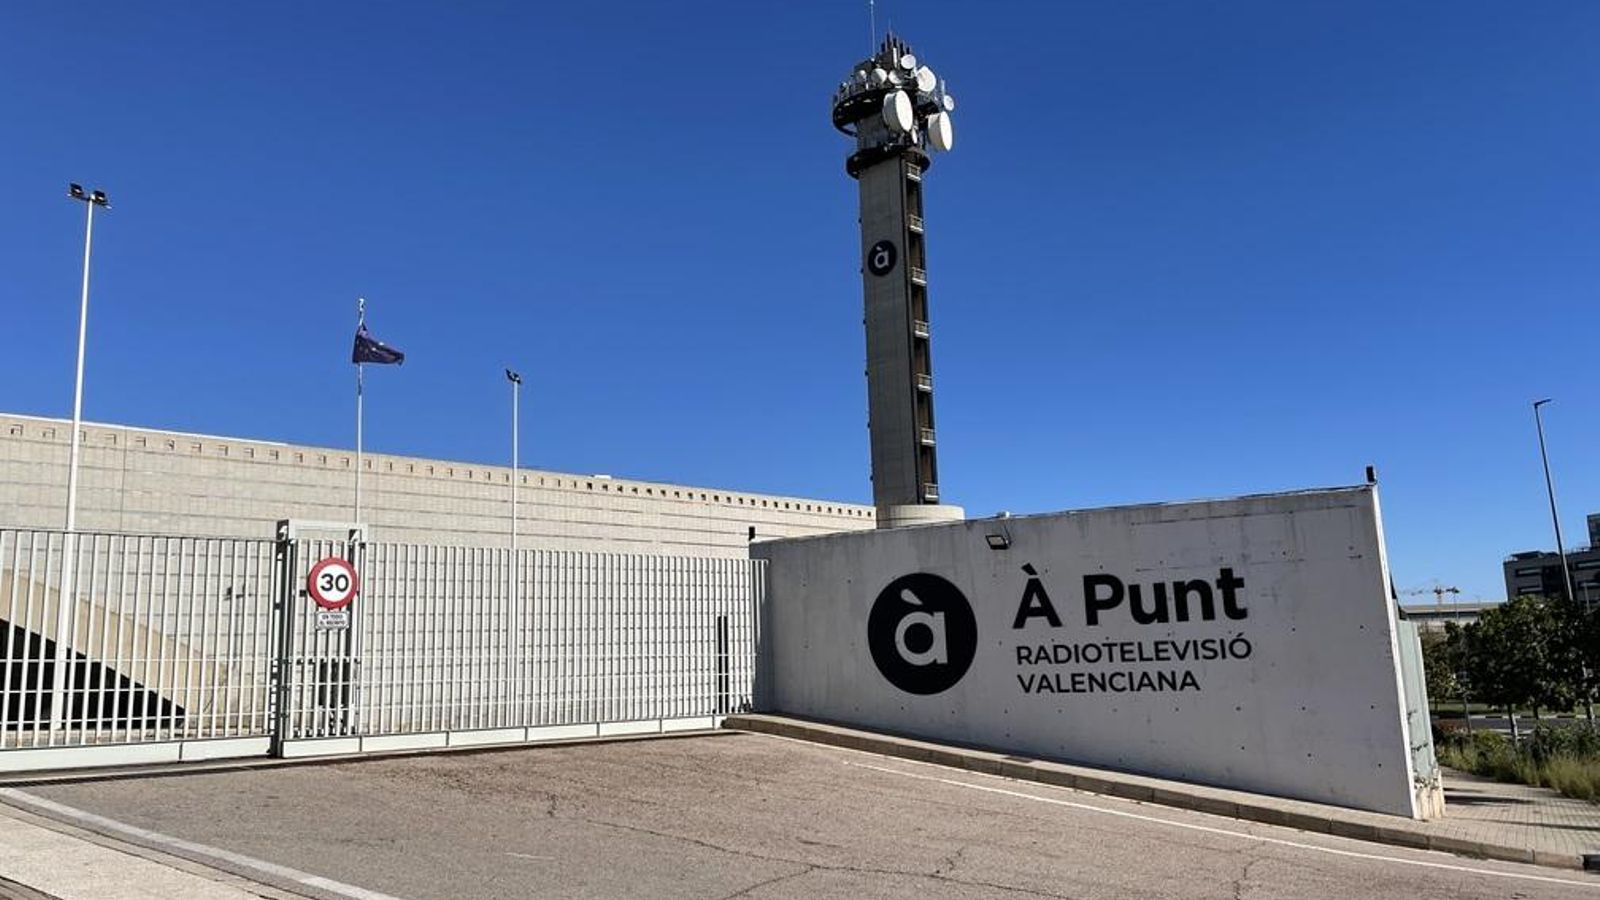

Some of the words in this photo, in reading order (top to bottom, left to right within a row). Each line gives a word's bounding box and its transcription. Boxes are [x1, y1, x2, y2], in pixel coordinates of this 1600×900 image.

[874, 246, 889, 268] à
[320, 573, 349, 592] 30
[1013, 562, 1063, 630] À
[1083, 567, 1248, 627] Punt
[895, 588, 948, 666] à
[1016, 632, 1253, 666] RADIOTELEVISIÓ
[1017, 670, 1201, 694] VALENCIANA
